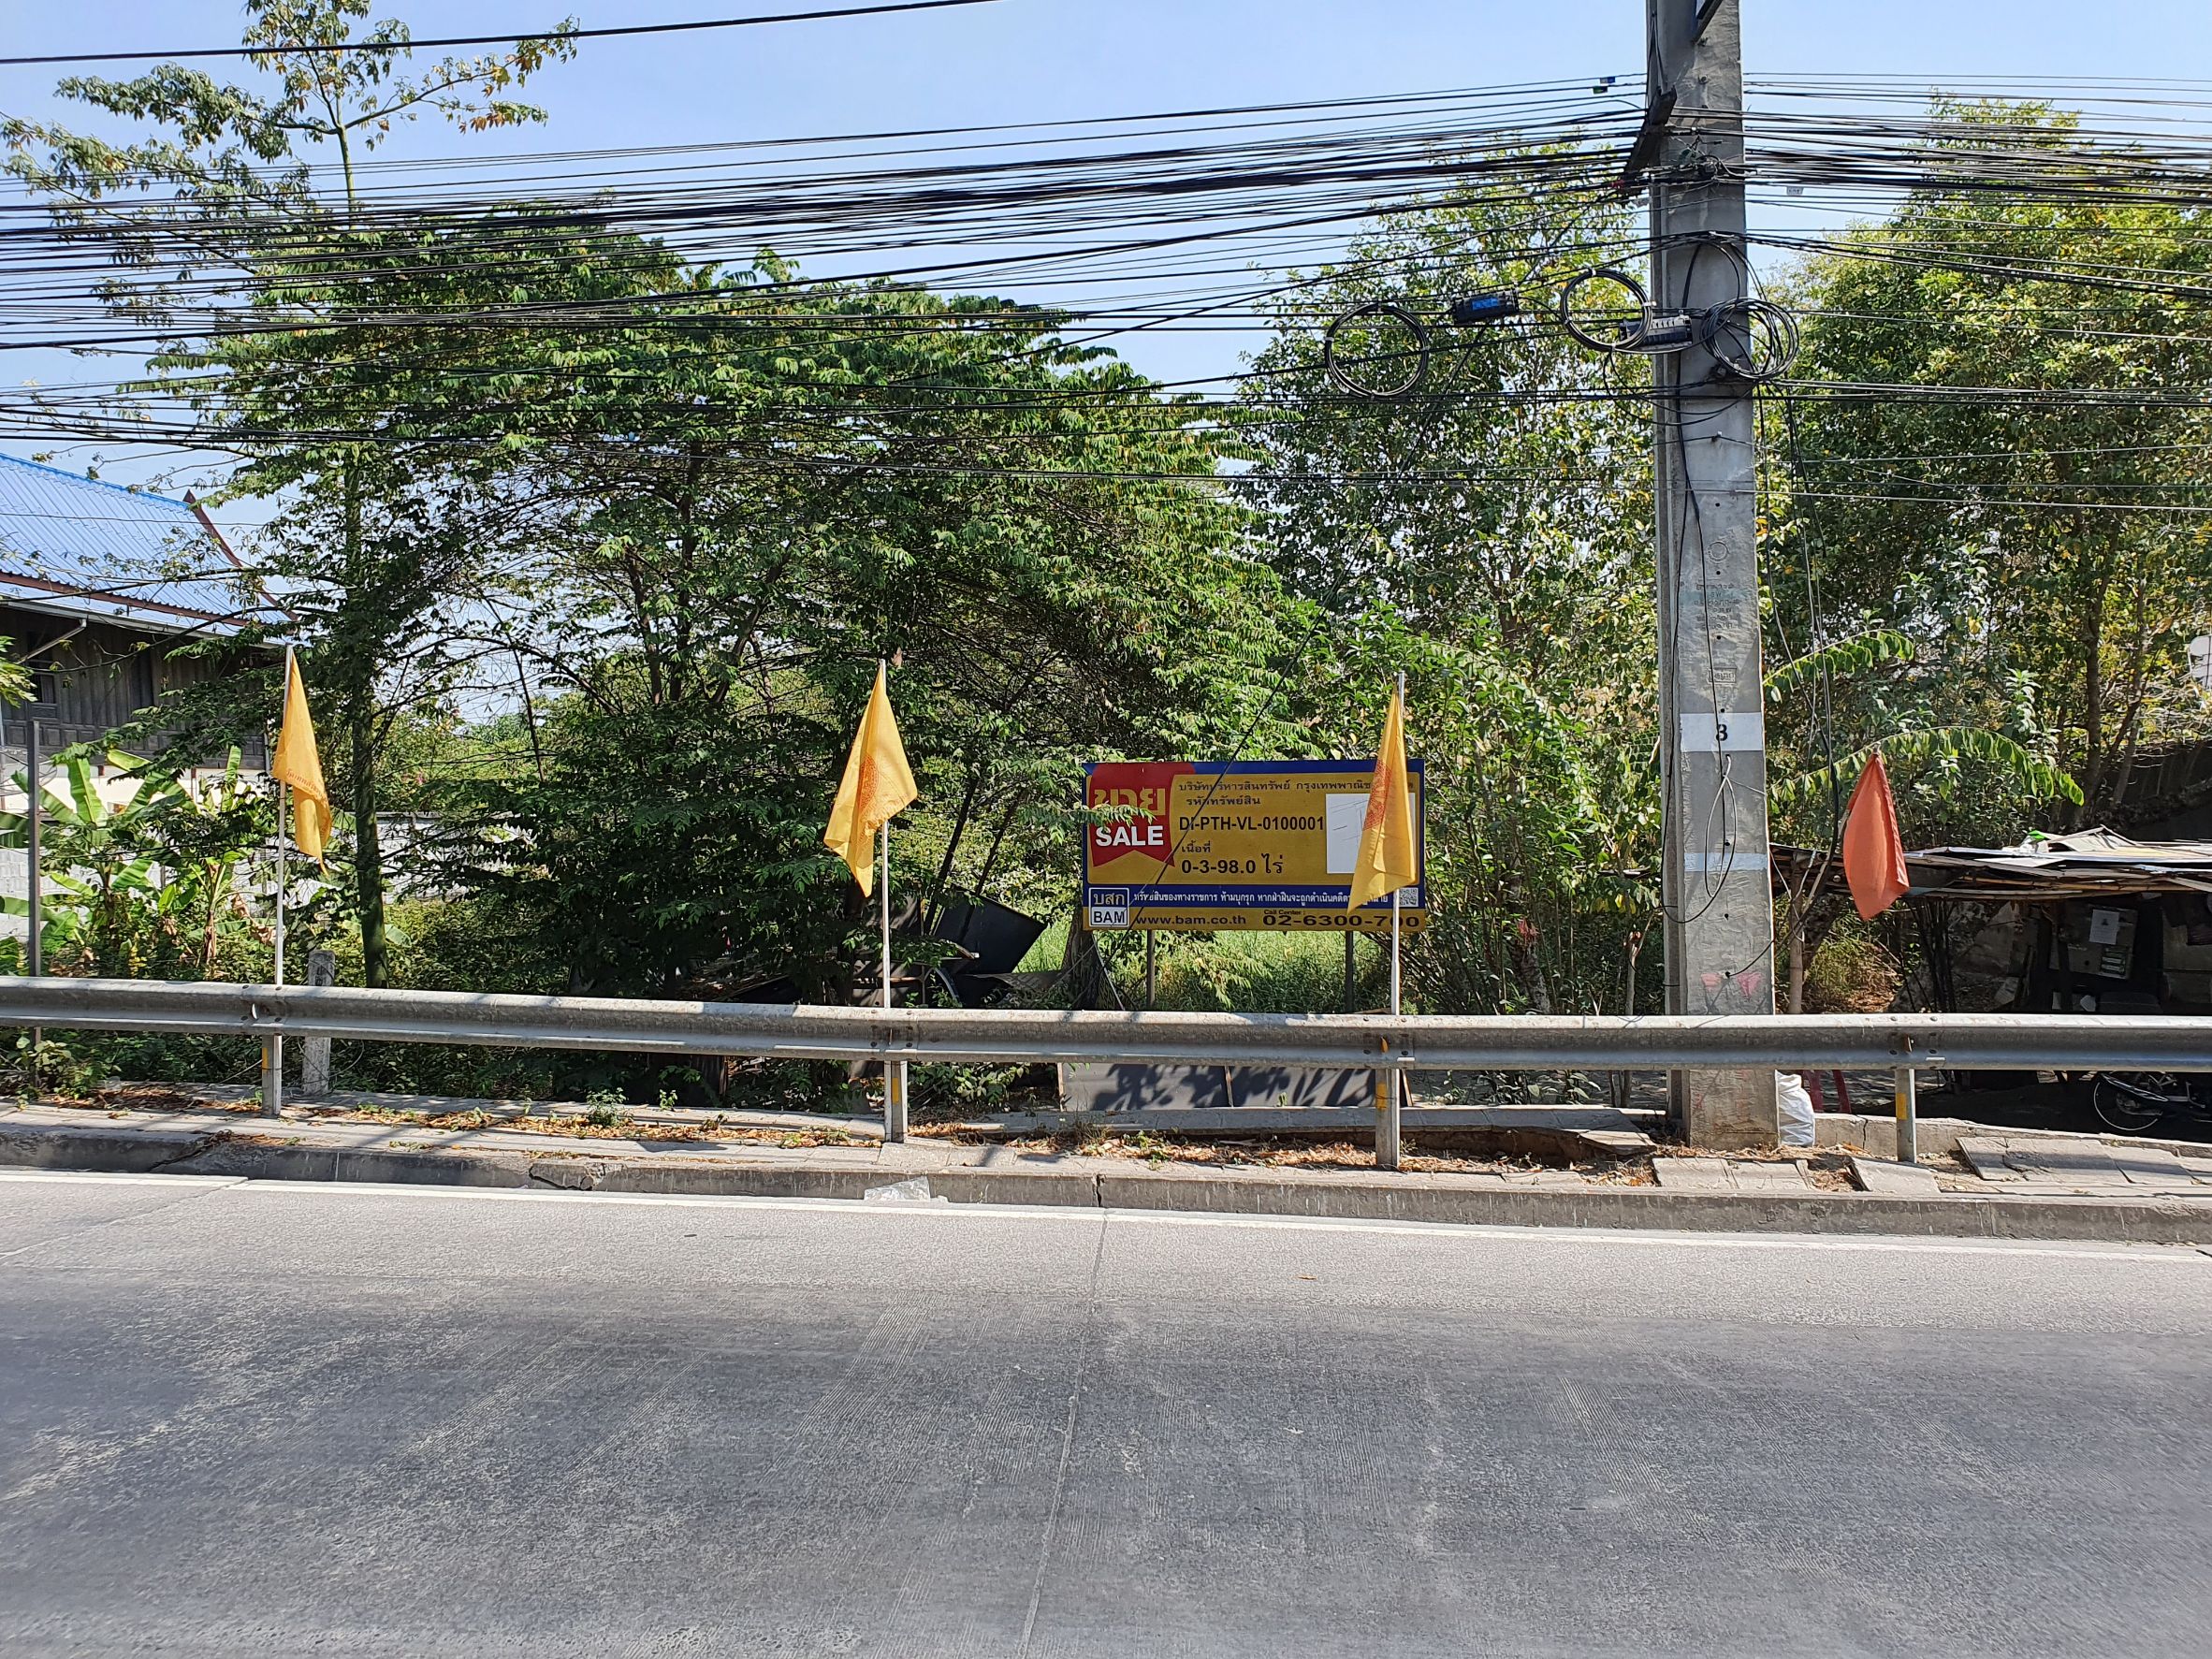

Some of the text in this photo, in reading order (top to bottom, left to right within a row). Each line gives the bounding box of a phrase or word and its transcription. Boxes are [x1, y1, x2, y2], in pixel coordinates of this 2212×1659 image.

[1179, 816, 1324, 831] DI-PTH-VL-0100001
[1096, 825, 1164, 847] SALE
[1181, 840, 1211, 853] เนื้อที่
[1181, 852, 1284, 874] 0-3-98.0 ไร่
[1093, 892, 1126, 906] บสก
[1093, 910, 1126, 924] BAM
[1136, 915, 1246, 925] www.bam.co.th
